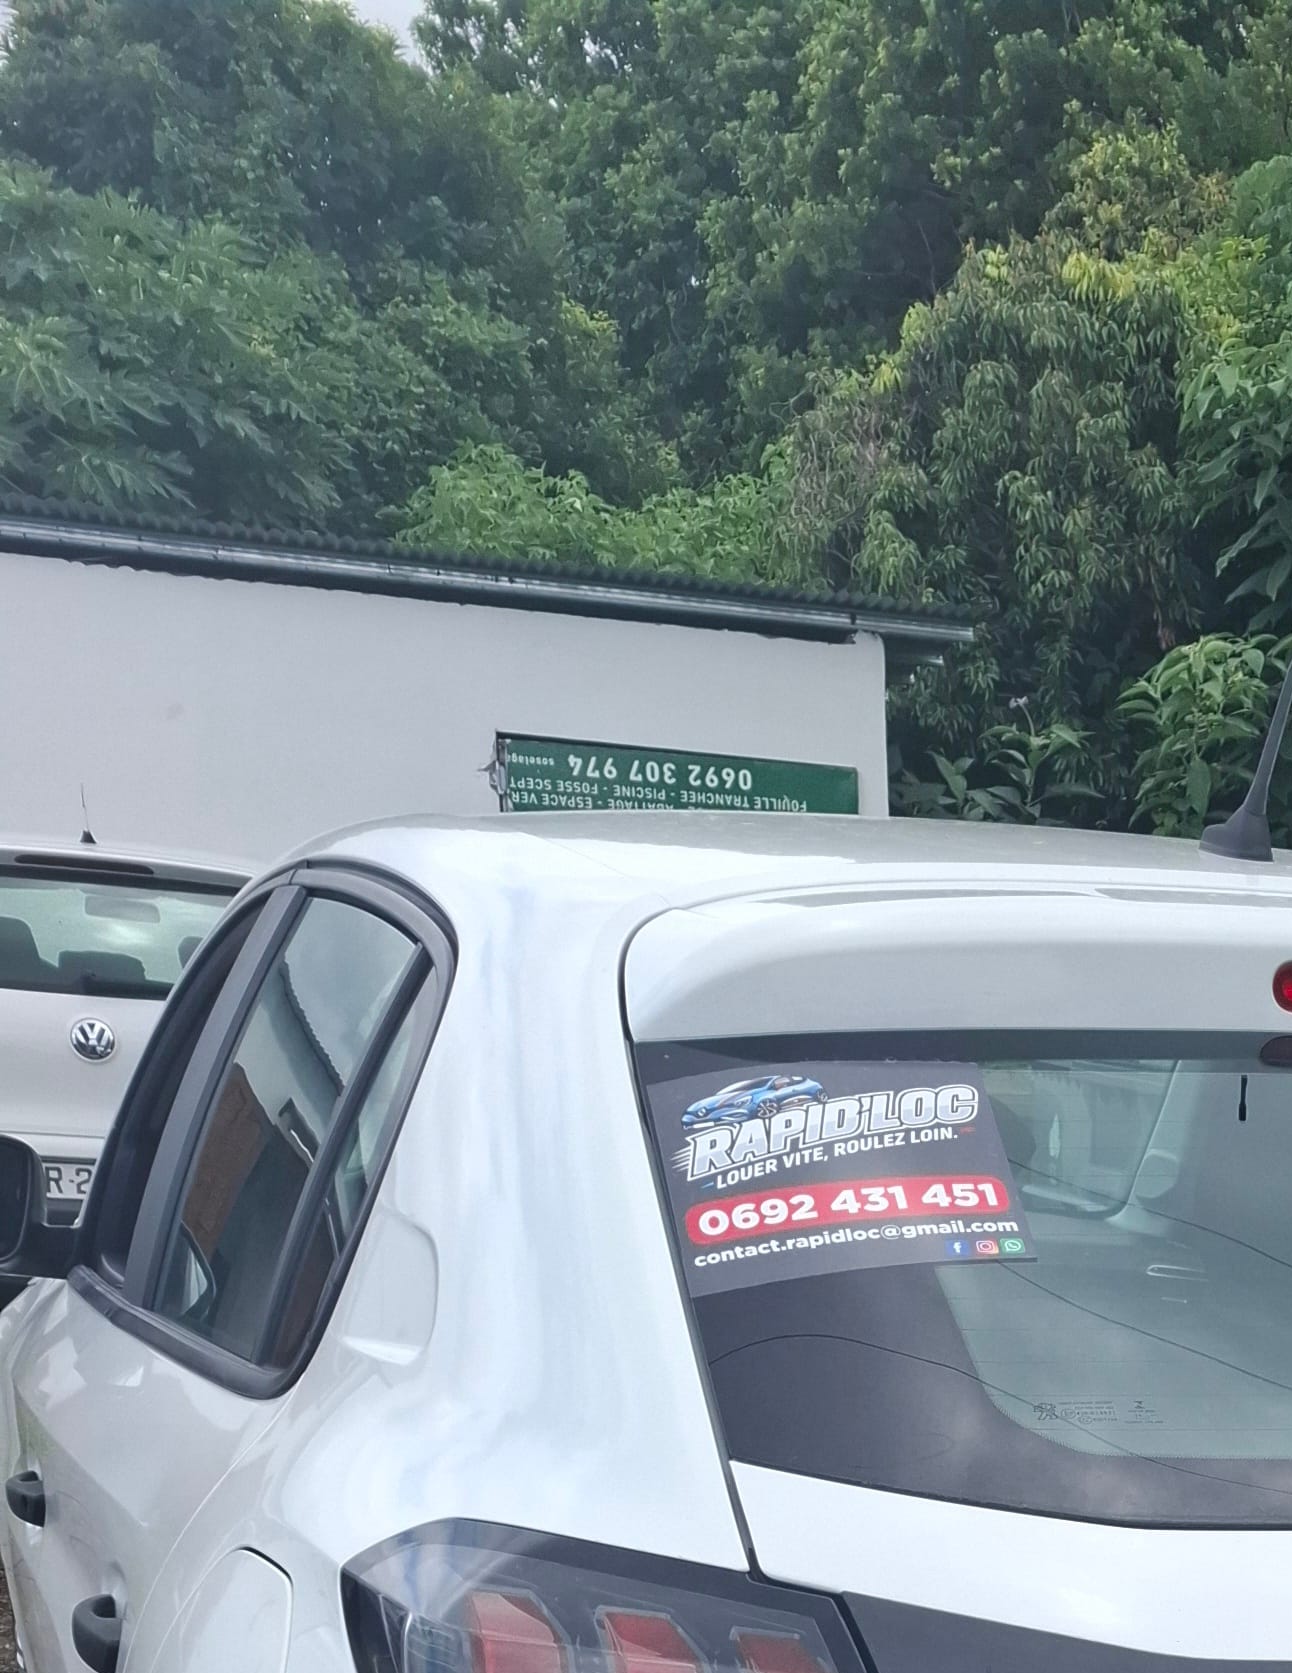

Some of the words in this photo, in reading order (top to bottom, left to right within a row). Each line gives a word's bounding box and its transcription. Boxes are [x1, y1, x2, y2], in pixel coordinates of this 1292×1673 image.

[567, 754, 617, 779] 974
[629, 759, 677, 785] 307
[688, 765, 752, 791] 0692
[556, 780, 598, 795] FOSSE
[613, 784, 666, 801] PISCINE
[680, 790, 750, 808] TRANCHEE
[541, 793, 592, 809] ESPACE
[753, 795, 807, 812] FOUILLE
[687, 1084, 979, 1181] RAPID'LOC
[715, 1160, 778, 1189] LOUER
[783, 1148, 829, 1169] VITE,
[834, 1132, 906, 1159] ROULEZ
[911, 1126, 959, 1143] LOIN.
[698, 1194, 819, 1237] 0692
[831, 1185, 909, 1214] 431
[921, 1183, 999, 1208] 451
[694, 1219, 1020, 1268] contact.rapidloc@gmail.com
